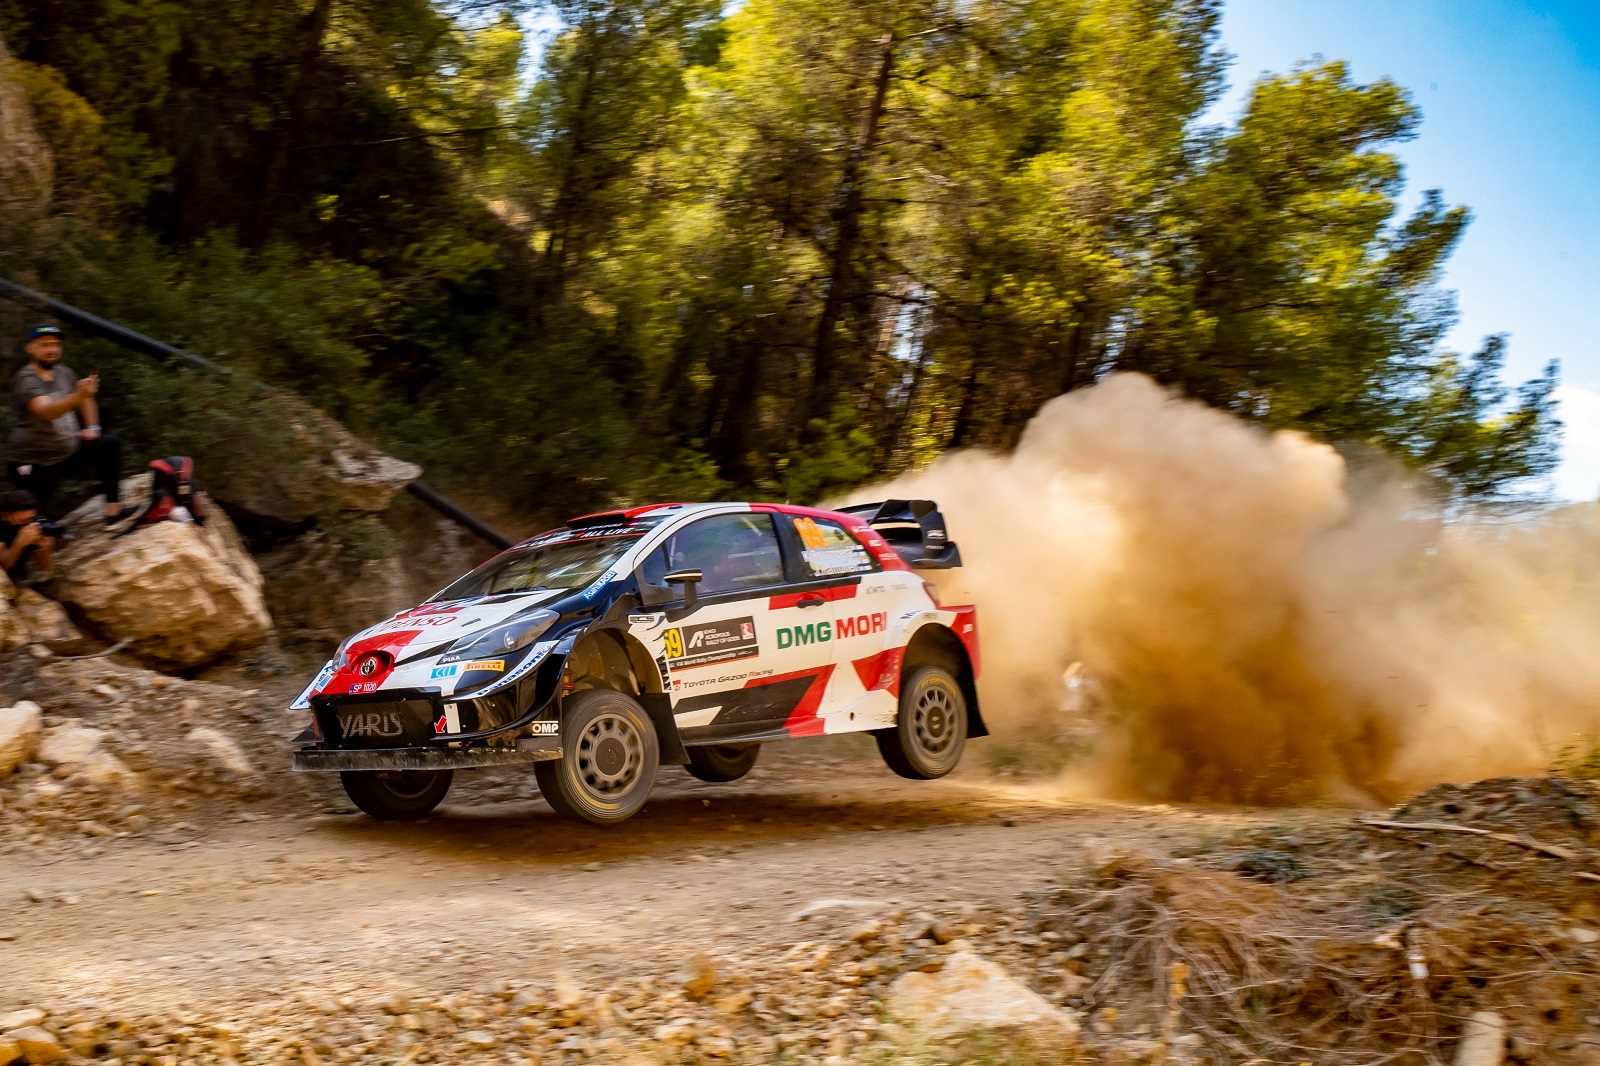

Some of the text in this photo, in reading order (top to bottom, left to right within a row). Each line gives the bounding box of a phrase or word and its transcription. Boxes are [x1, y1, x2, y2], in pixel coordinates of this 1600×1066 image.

[776, 611, 887, 649] DMG MORI
[443, 655, 461, 663] PIAA
[477, 645, 552, 696] Panasonic
[683, 678, 716, 689] TOYOTA
[337, 711, 404, 739] YARIS
[531, 722, 559, 734] OMP
